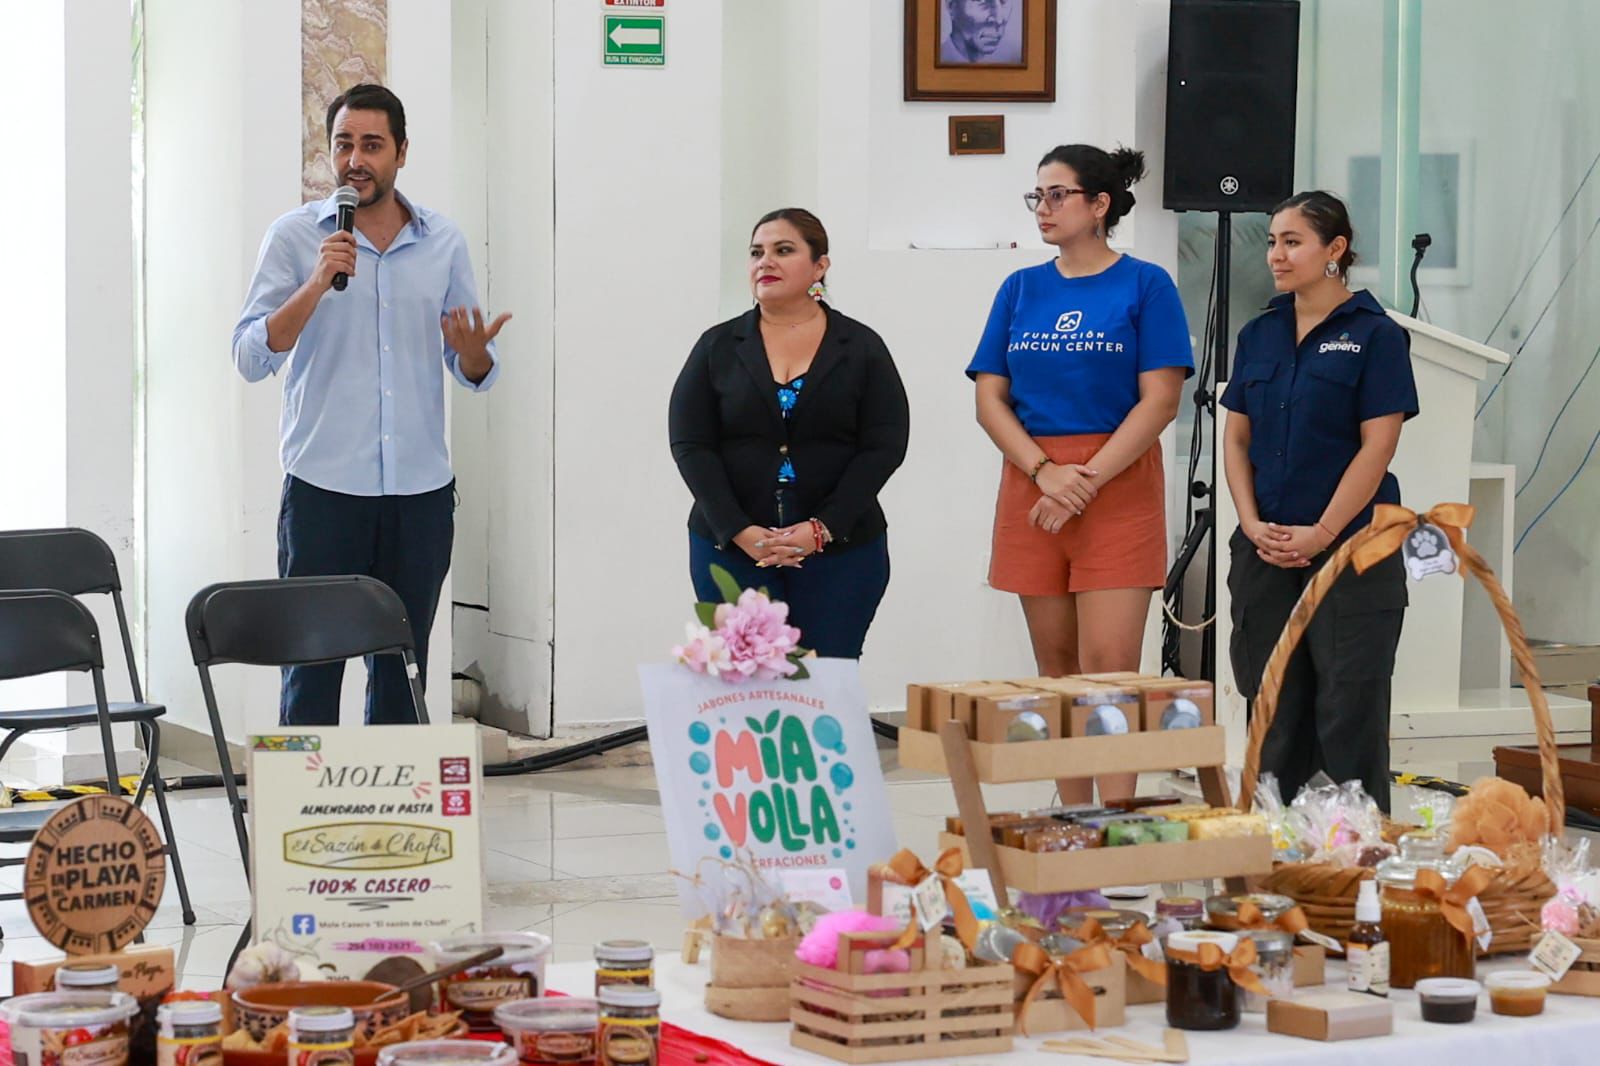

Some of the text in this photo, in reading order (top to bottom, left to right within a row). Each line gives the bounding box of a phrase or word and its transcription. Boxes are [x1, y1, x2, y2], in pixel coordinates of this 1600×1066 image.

[1023, 330, 1105, 340] FUNDACIÓN
[1065, 341, 1124, 352] CENTER
[1318, 342, 1361, 353] genera
[697, 689, 825, 714] JABONES ARTESANALES
[317, 765, 415, 788] MOLE
[300, 803, 433, 815] ALMENDRADO EN PASTA
[713, 782, 841, 852] VOLLA
[57, 841, 136, 866] HECHO
[310, 832, 366, 854] Sazón
[385, 832, 441, 862] Chofi
[66, 863, 141, 891] PLAYA
[308, 877, 431, 895] 100% CASERO
[57, 890, 136, 913] CARMEN
[319, 921, 339, 929] Mole
[342, 921, 370, 929] Casero
